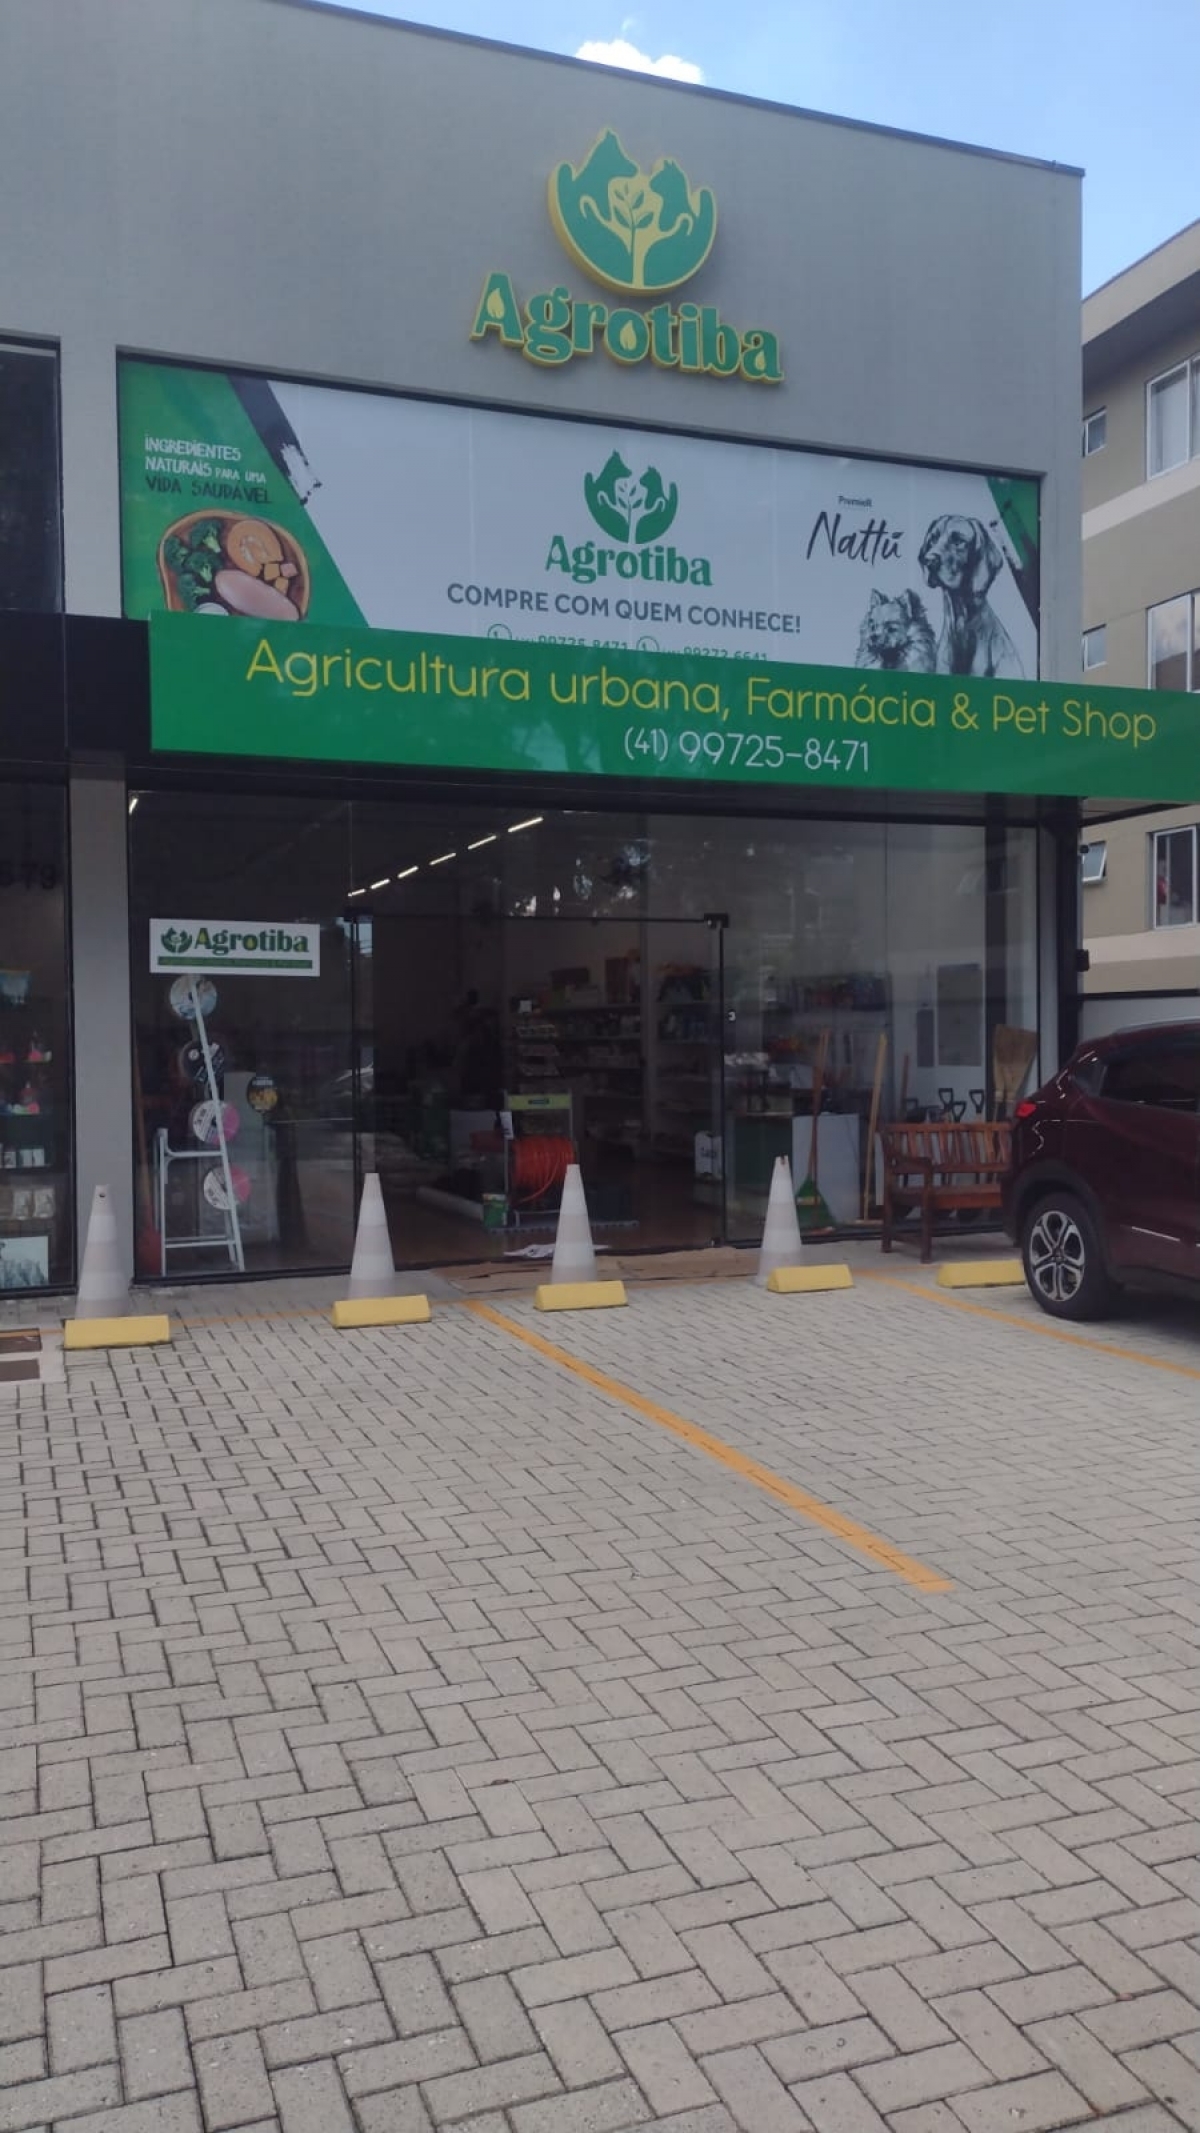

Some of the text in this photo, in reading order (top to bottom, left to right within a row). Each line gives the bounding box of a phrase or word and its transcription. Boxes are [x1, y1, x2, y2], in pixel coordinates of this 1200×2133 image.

[470, 272, 784, 384] Agrotiba
[145, 435, 241, 461] INGREDIENTES
[145, 456, 266, 483] NATURAIS PARA UMA
[146, 476, 272, 504] VIDA SAUDÁVEL
[546, 535, 713, 586] Agrotiba
[806, 511, 904, 566] Nattú
[447, 583, 801, 633] COMPRE COM QUEM CONHECE!
[246, 639, 1157, 747] Agricultura urbana, Farmácia & Pet Shop
[624, 726, 869, 772] (41) 99725-8471
[195, 927, 309, 956] Agrotiba
